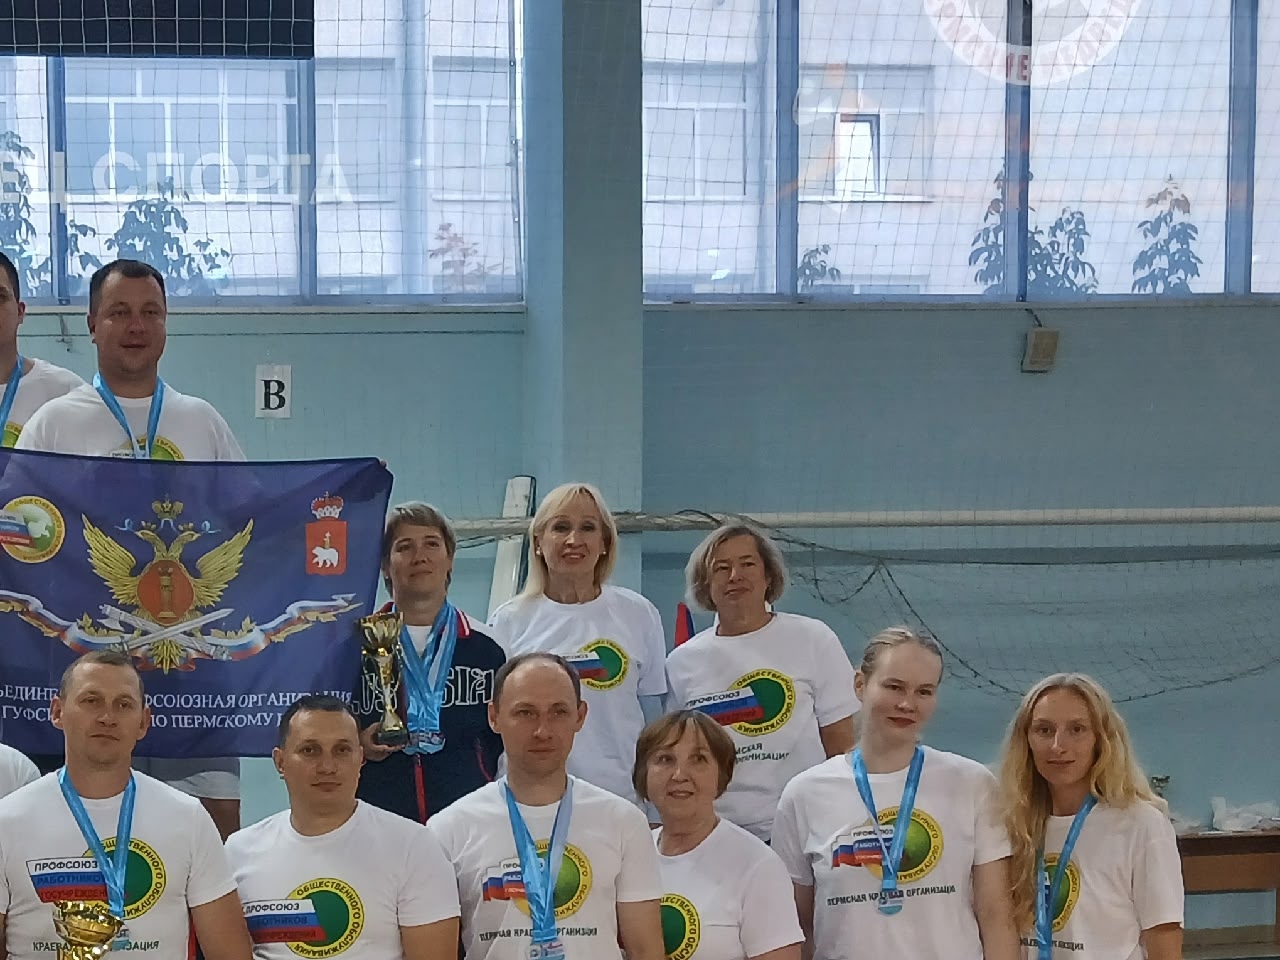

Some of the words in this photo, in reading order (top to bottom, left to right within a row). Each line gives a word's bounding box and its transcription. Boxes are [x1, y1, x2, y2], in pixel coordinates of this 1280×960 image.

[144, 693, 236, 709] ФСОЮЗНАЯ
[171, 712, 274, 728] ПЕРМСКОМУ
[34, 860, 98, 873] ПРОФСОЮЗ
[296, 881, 361, 919] ОБЩЕСТВЕННОГО
[246, 903, 300, 914] ПРОФСОЮЗ
[33, 941, 69, 951] КРАЕВА
[294, 921, 360, 957] ОБСЛУЖИВАНИЯ
